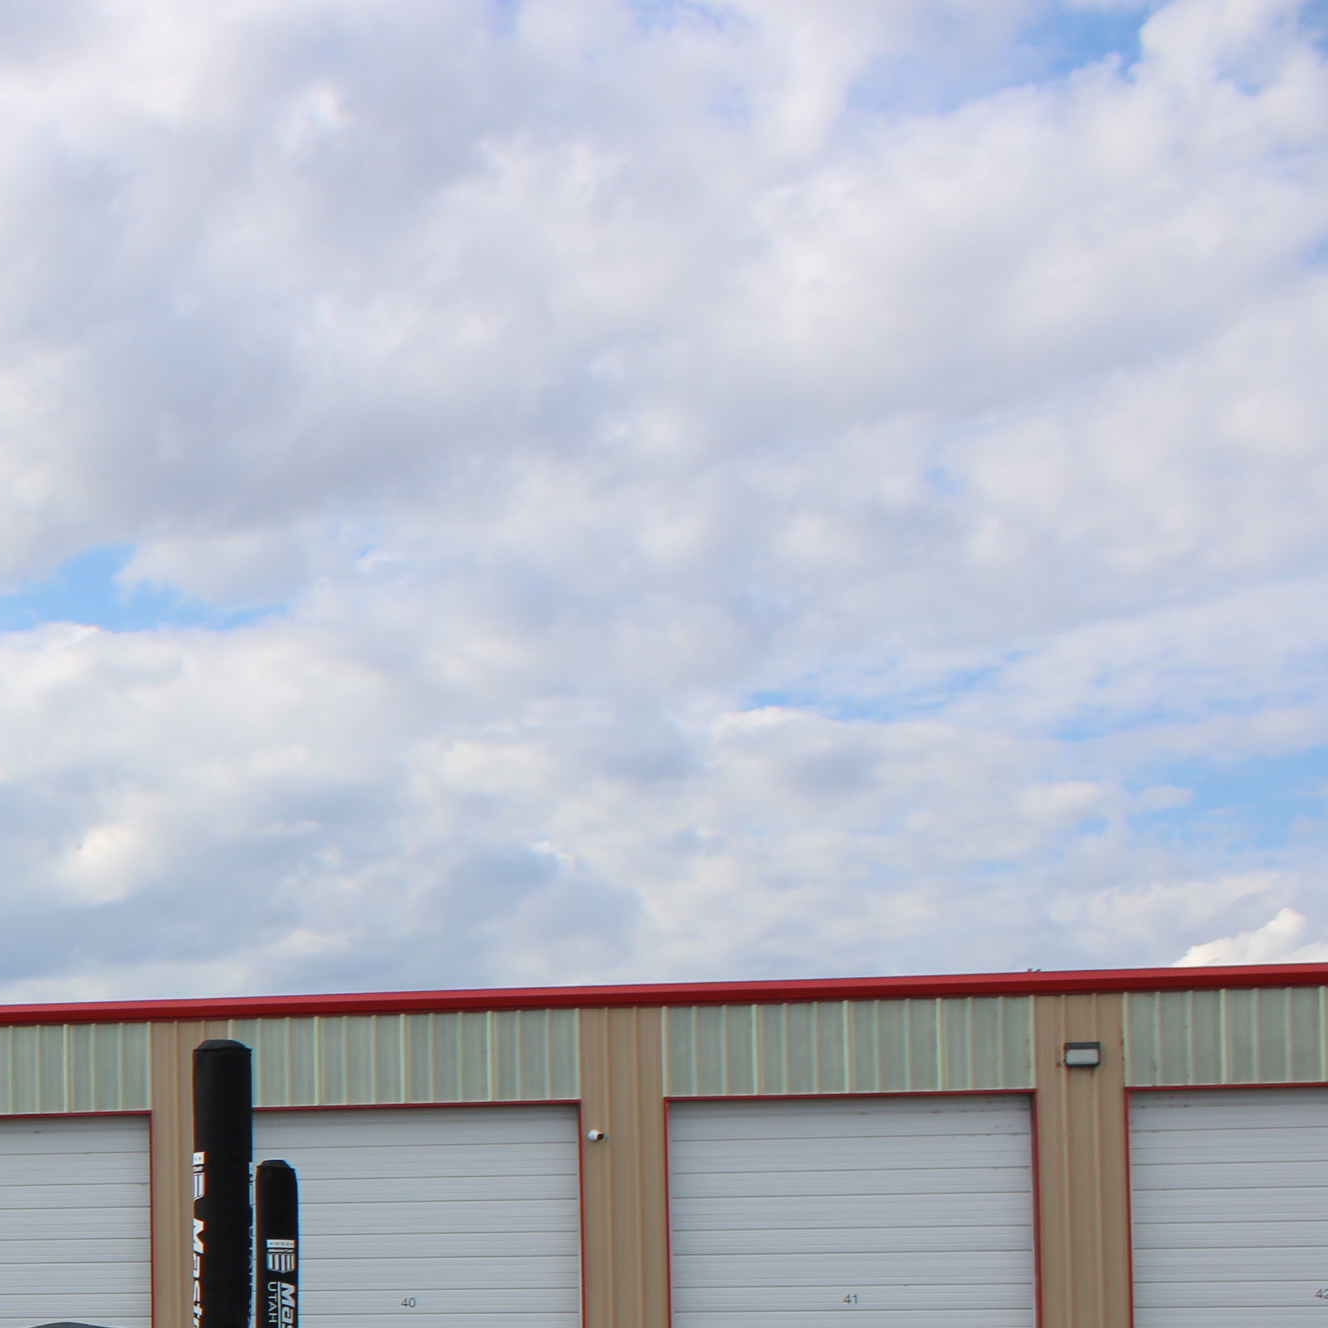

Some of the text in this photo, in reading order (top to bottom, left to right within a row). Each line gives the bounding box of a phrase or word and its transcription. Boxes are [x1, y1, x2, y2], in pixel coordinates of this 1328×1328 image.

[267, 1282, 278, 1323] UTAH
[401, 1297, 416, 1308] 40
[843, 1294, 858, 1304] 41
